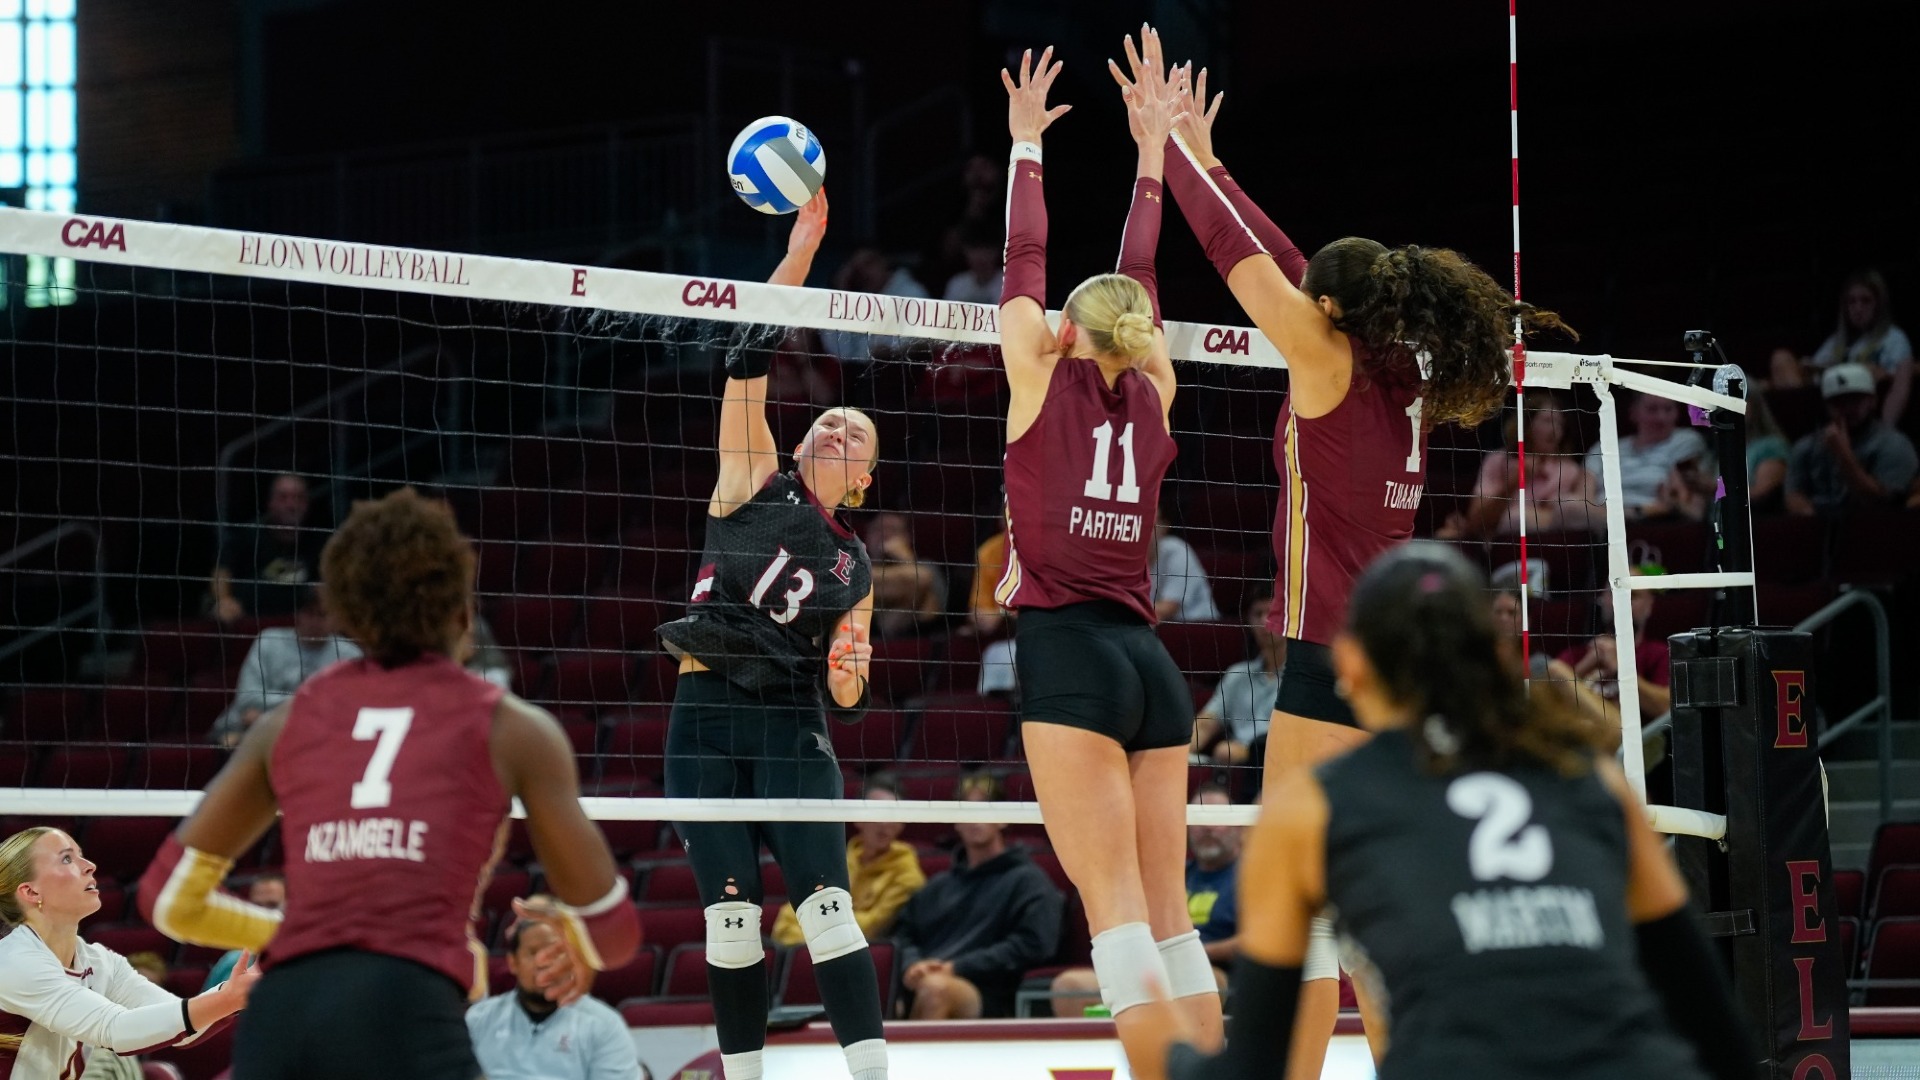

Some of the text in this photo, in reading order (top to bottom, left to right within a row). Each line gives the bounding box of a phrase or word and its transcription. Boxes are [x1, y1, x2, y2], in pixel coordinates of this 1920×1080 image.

[61, 218, 127, 252] CAA
[238, 235, 471, 286] ELON VOLLEYBALL
[571, 268, 588, 297] E
[681, 279, 738, 310] CAA
[828, 292, 1001, 334] ELON VOLLEYBA
[1203, 327, 1250, 356] CAA
[1405, 397, 1424, 473] 1
[1083, 419, 1141, 504] 11
[1069, 506, 1142, 543] PARTHEN
[748, 545, 815, 625] 13
[1770, 670, 1809, 749] E
[350, 706, 416, 810] 7
[1446, 771, 1554, 882] 2
